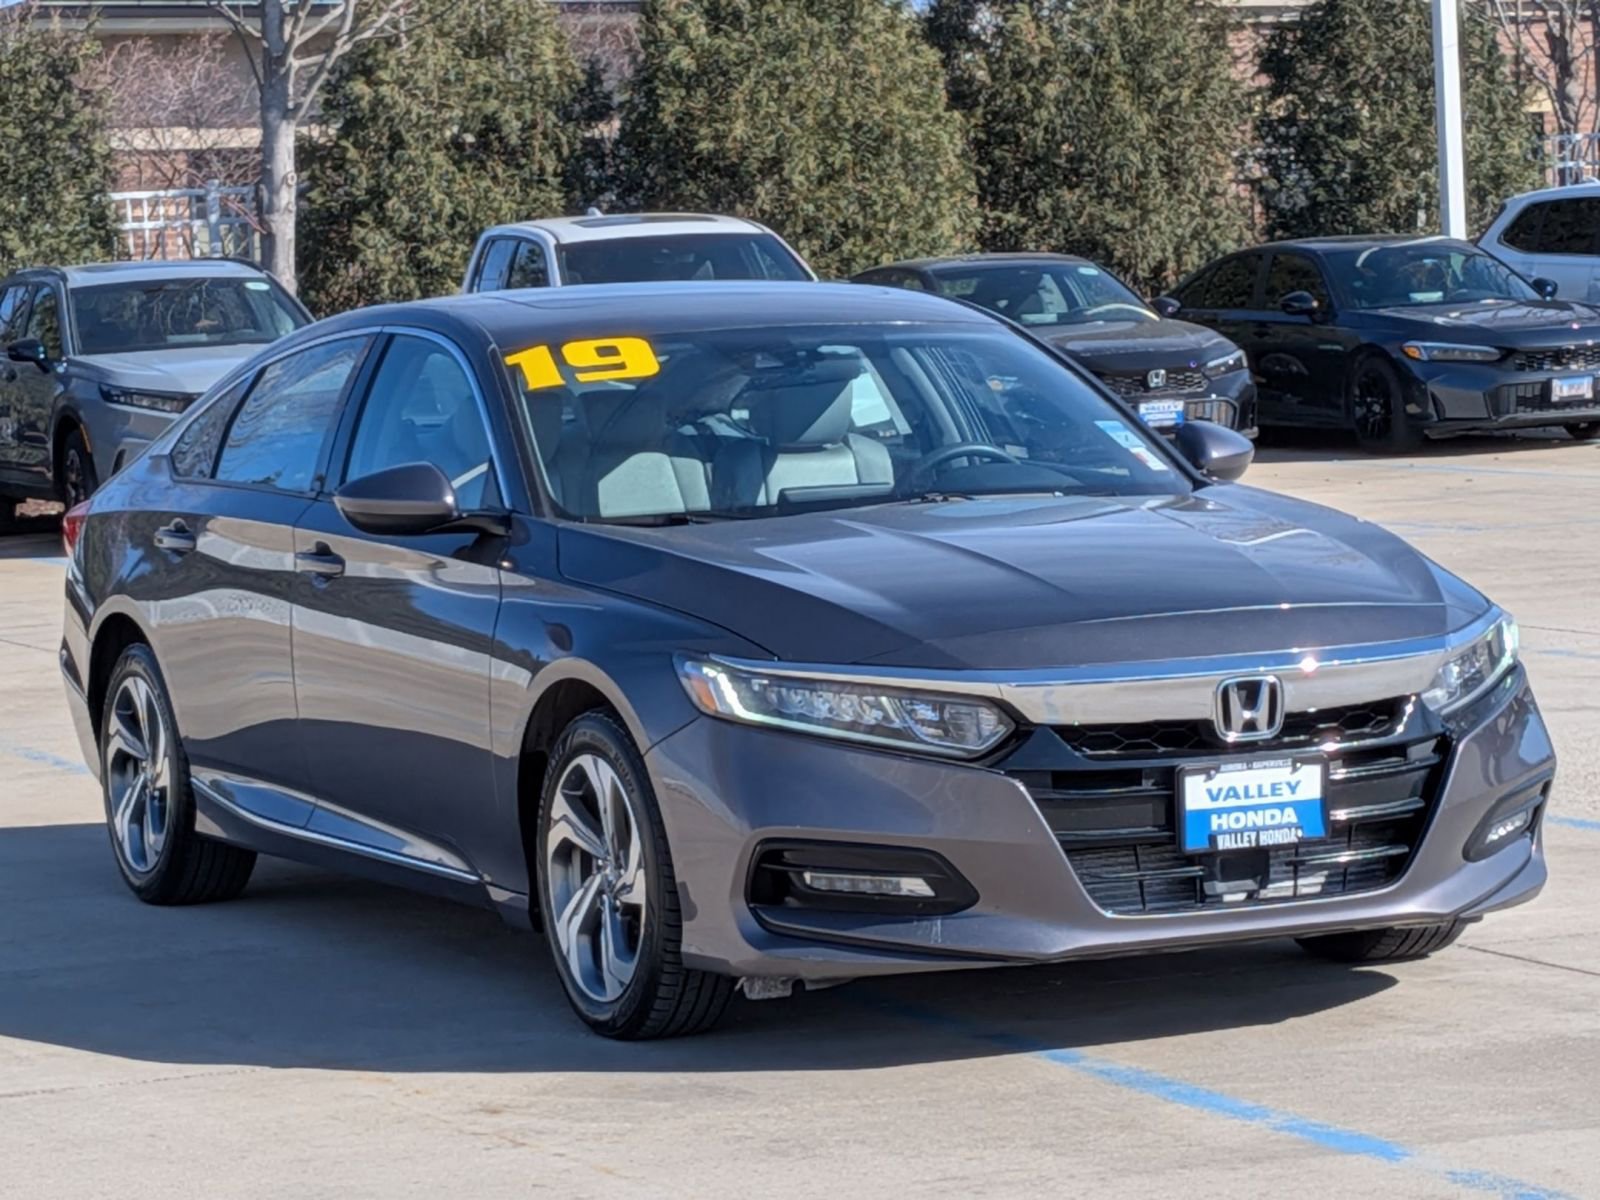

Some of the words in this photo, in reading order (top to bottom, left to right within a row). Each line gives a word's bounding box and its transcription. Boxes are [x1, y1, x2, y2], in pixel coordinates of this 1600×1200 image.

[504, 337, 660, 390] 19
[1206, 780, 1301, 803] VALLEY
[1210, 807, 1298, 831] HONDA
[1217, 831, 1257, 850] VALLEY
